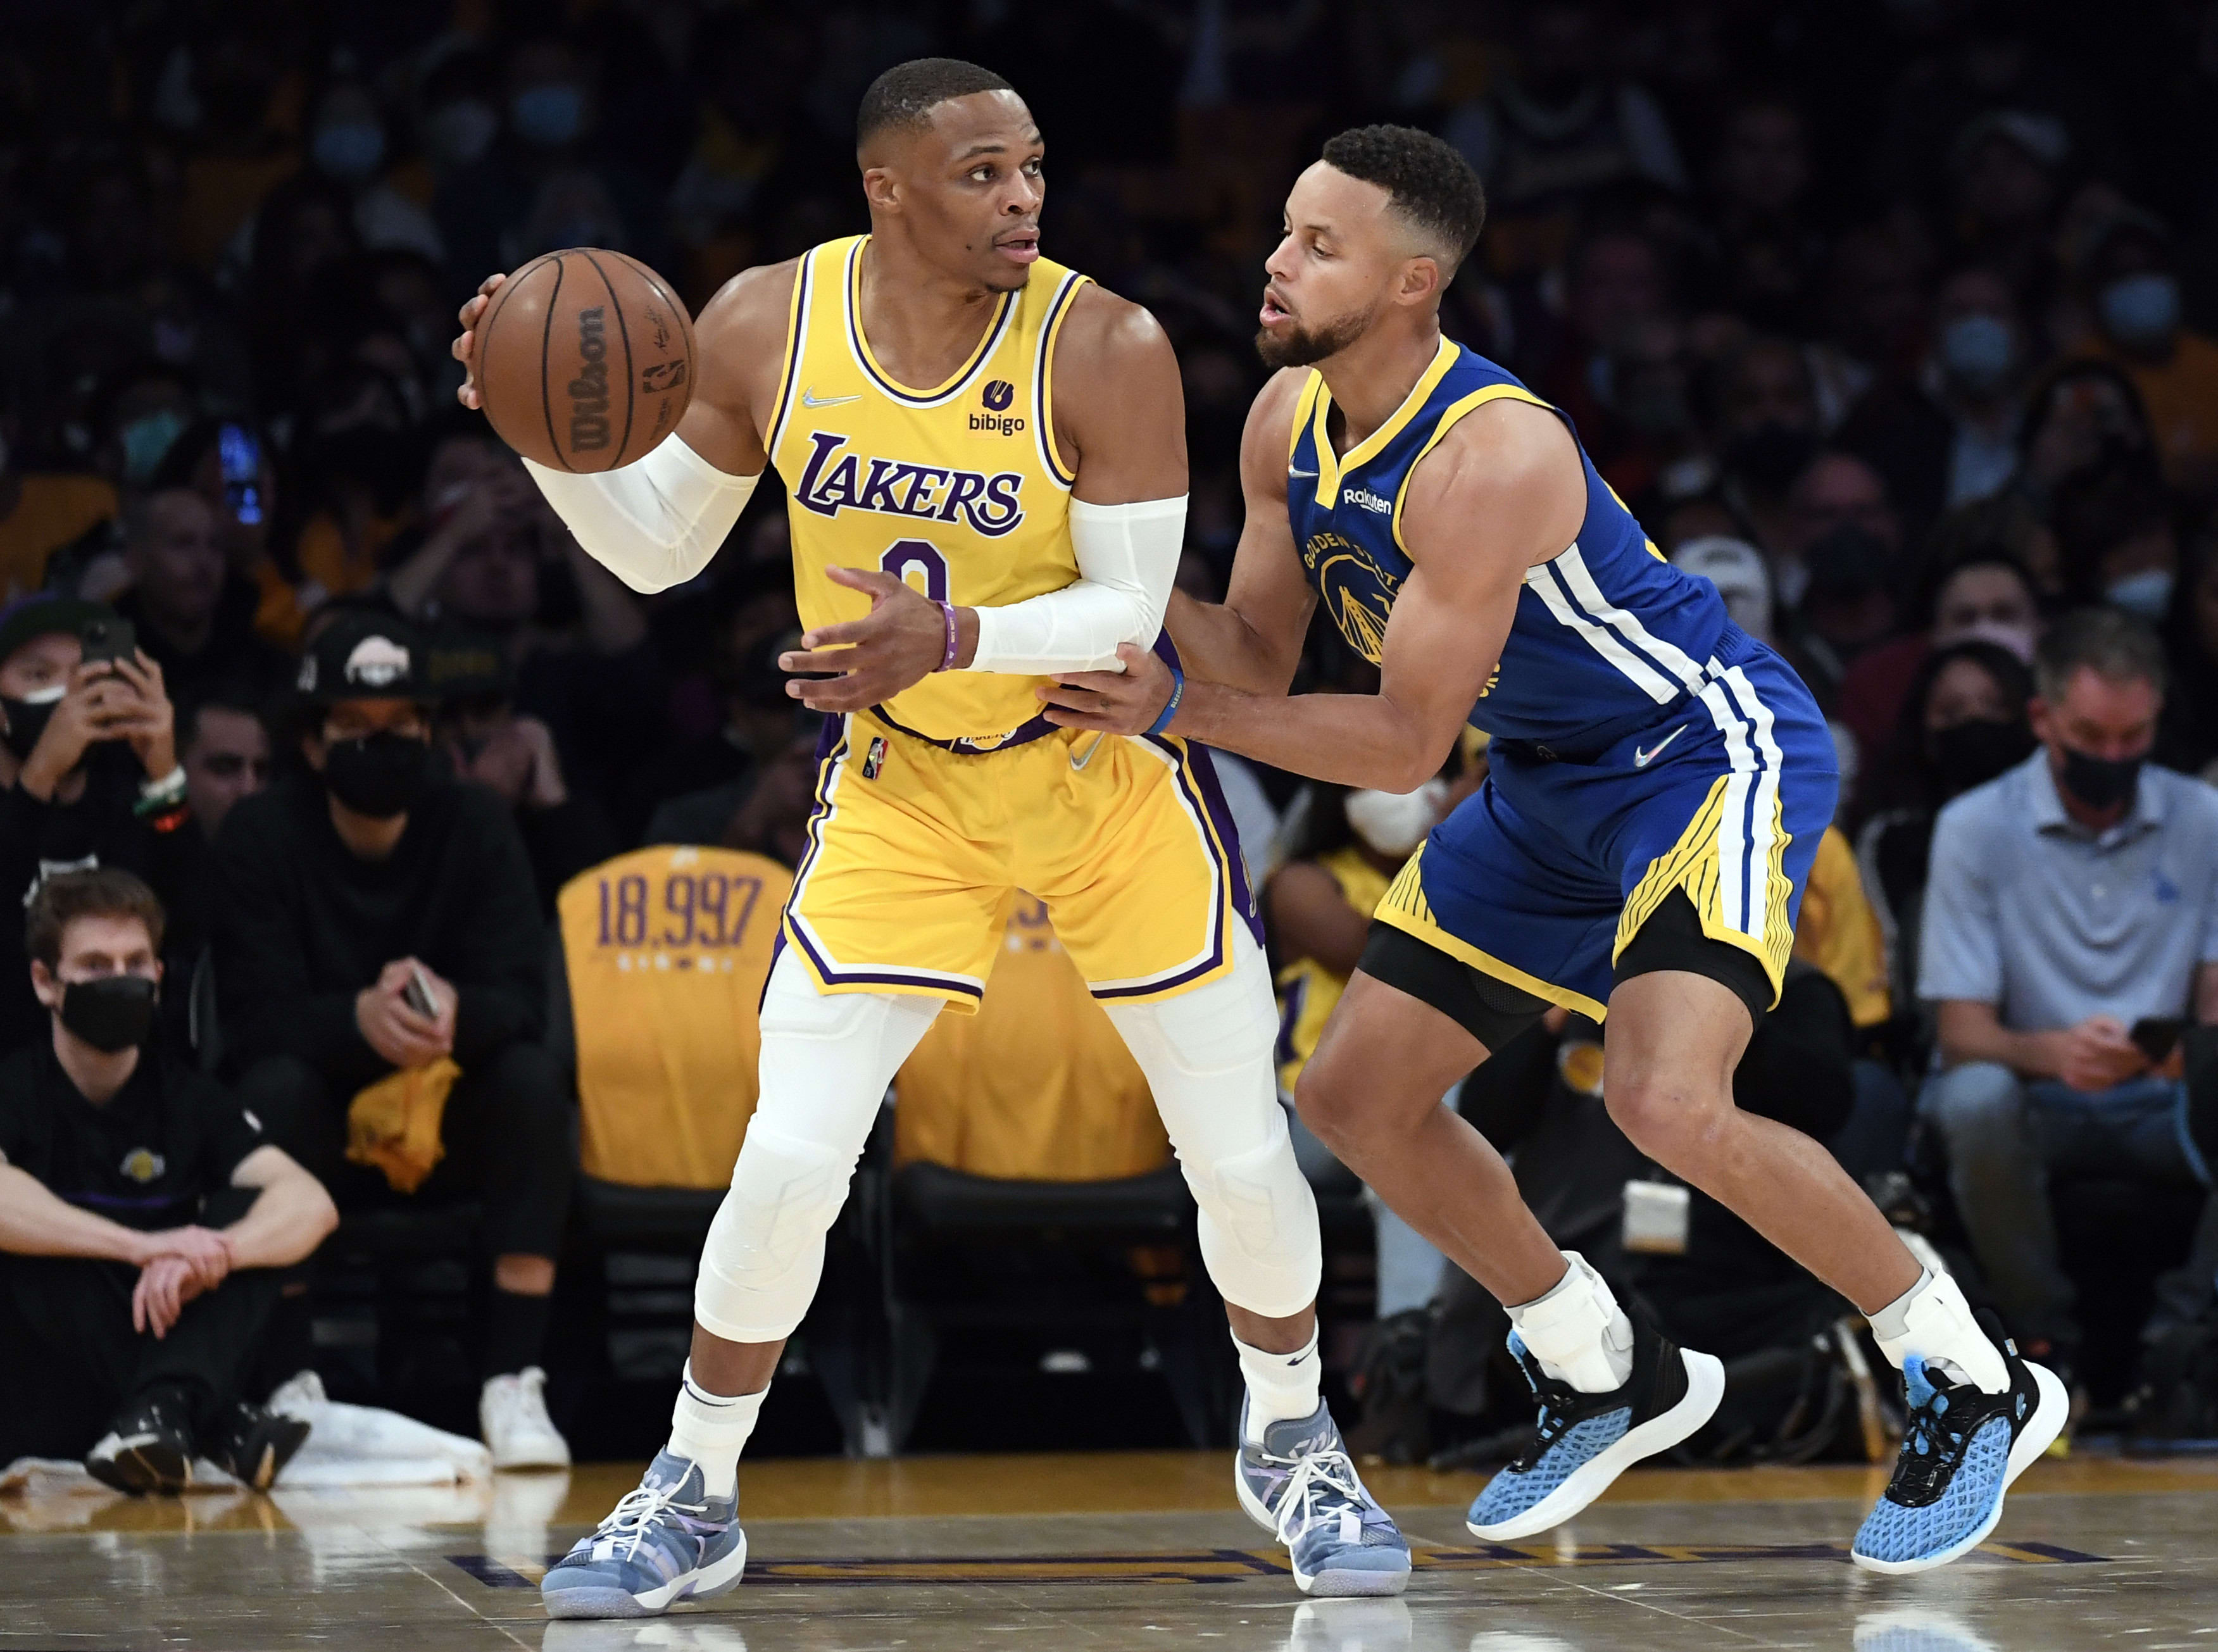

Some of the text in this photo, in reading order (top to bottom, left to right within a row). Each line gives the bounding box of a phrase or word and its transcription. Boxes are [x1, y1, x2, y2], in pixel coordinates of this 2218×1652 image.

[567, 305, 611, 453] Wilson
[968, 413, 1025, 437] bibigo
[793, 430, 1027, 539] LAKERS
[1343, 487, 1392, 515] Rakuten
[1304, 532, 1351, 570] GOLDEN
